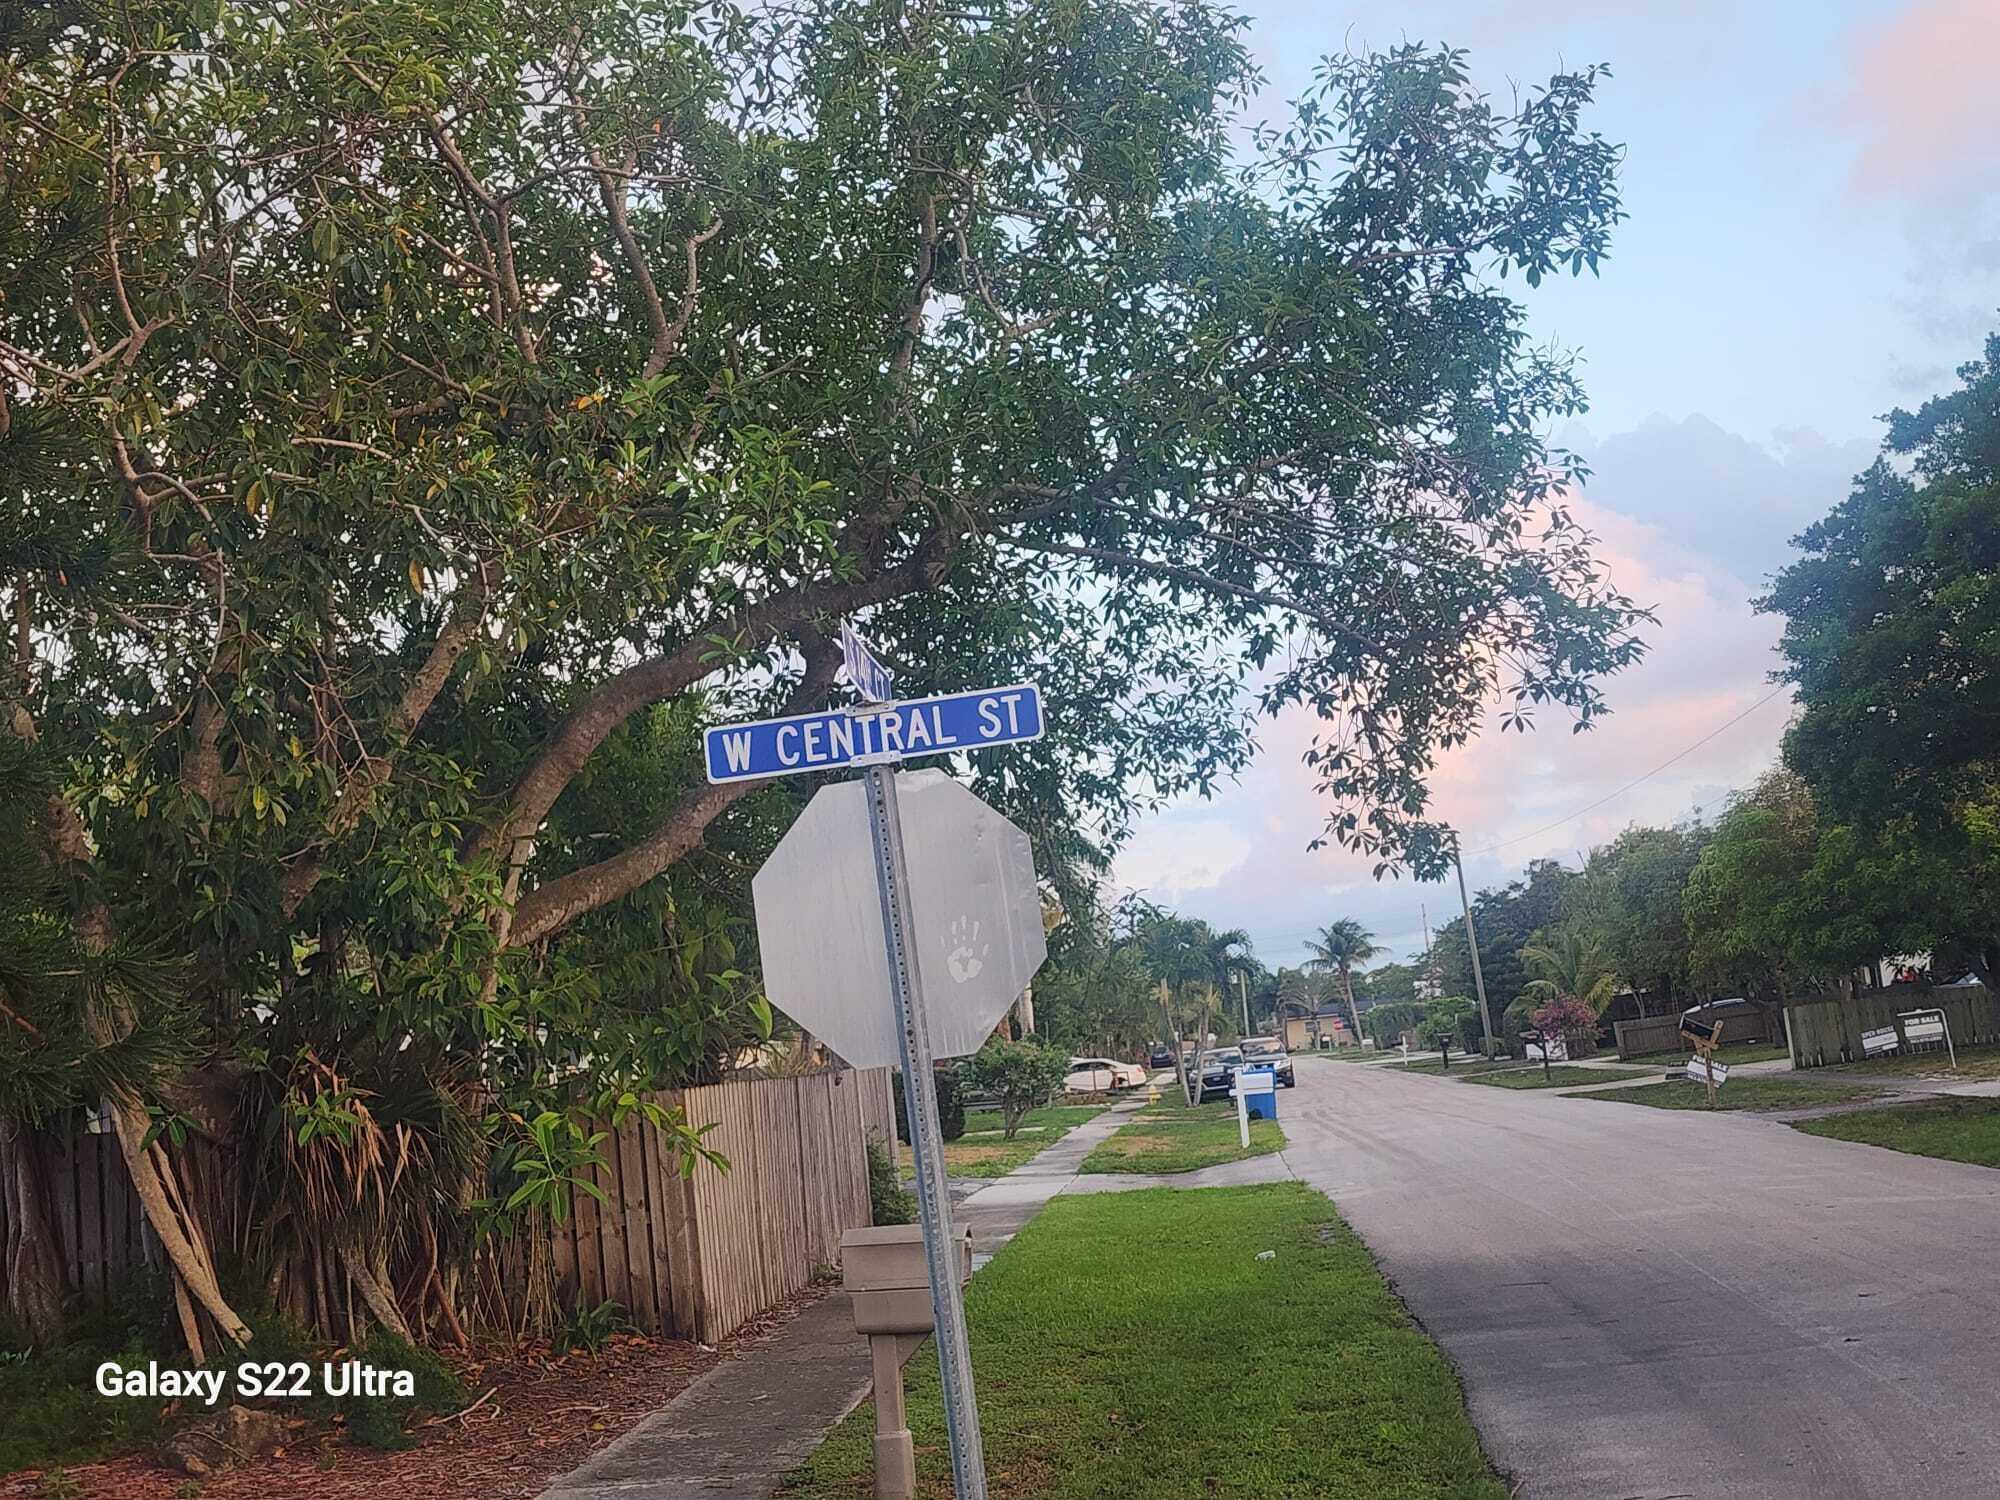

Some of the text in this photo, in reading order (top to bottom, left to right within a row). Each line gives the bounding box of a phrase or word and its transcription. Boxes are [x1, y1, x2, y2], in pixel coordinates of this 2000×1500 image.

[722, 694, 1022, 773] W CENTRAL ST
